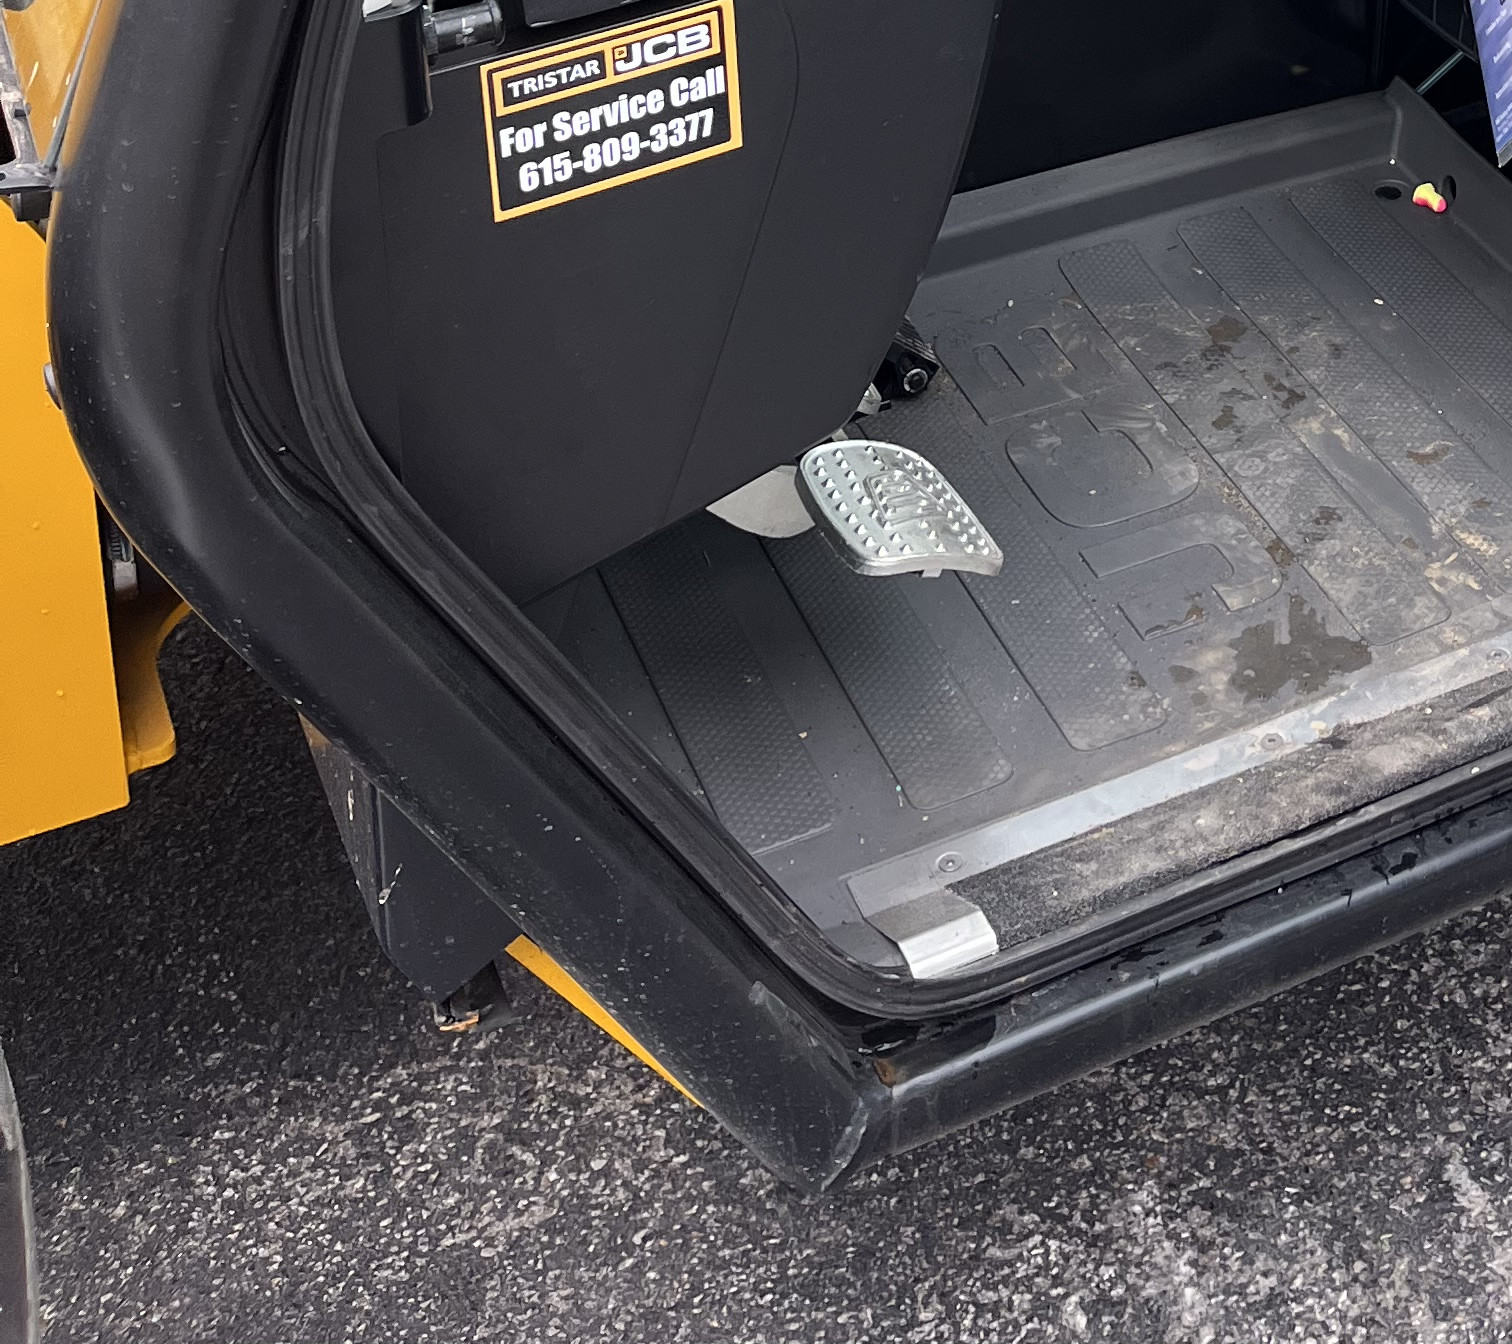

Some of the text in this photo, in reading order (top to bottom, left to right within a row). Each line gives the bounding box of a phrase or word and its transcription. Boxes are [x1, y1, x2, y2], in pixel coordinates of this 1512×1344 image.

[507, 23, 711, 98] TRISTAR JCB
[499, 65, 726, 159] For Service Call
[518, 108, 714, 193] 615-809-3377
